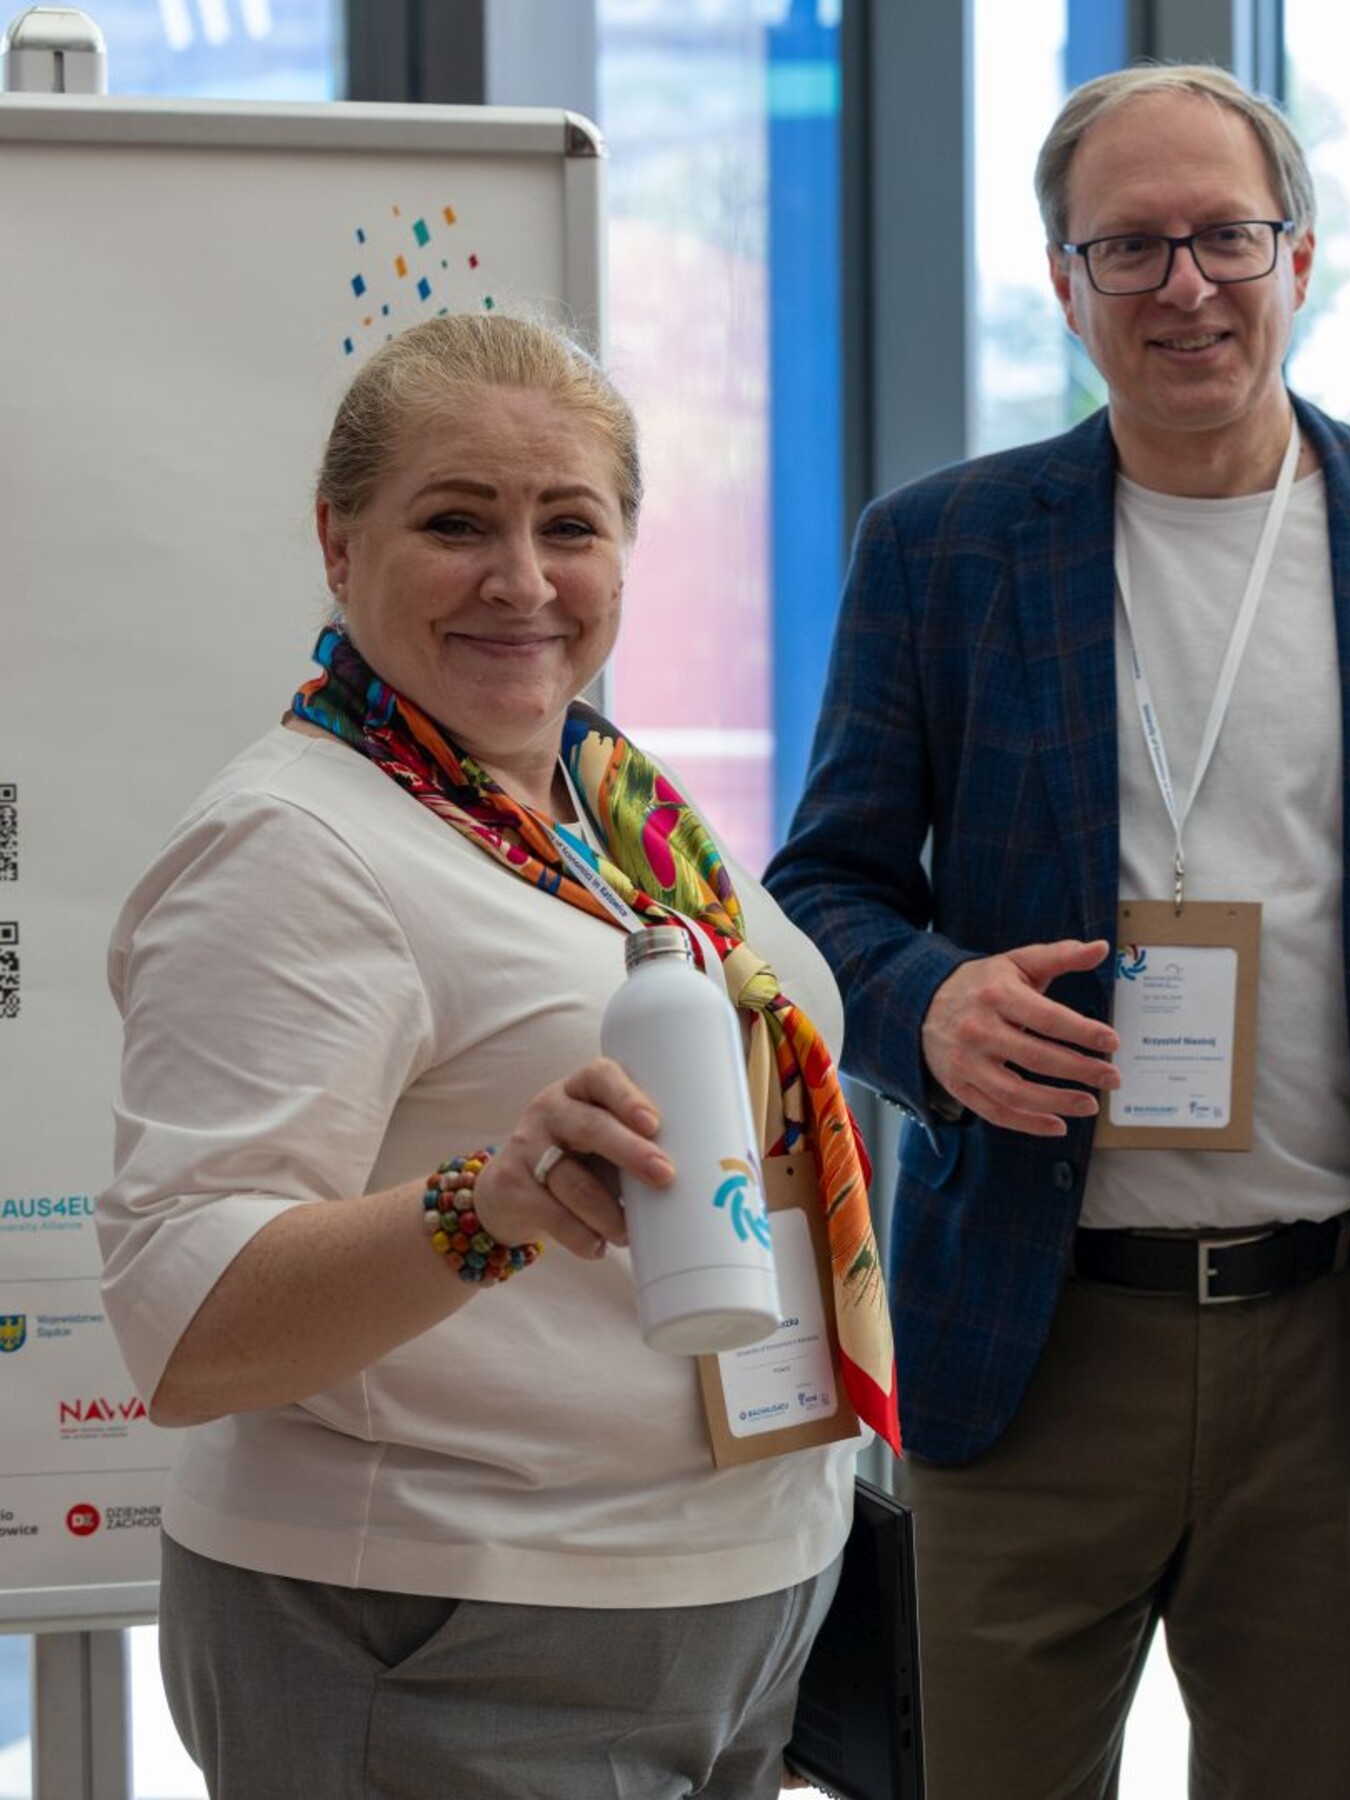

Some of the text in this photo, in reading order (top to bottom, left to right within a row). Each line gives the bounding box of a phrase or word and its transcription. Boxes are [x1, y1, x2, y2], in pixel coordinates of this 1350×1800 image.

[562, 846, 594, 882] Economics
[591, 878, 601, 889] in
[600, 886, 628, 917] Katowice
[1142, 1036, 1181, 1047] Krzysztof
[60, 1397, 147, 1425] NAWA
